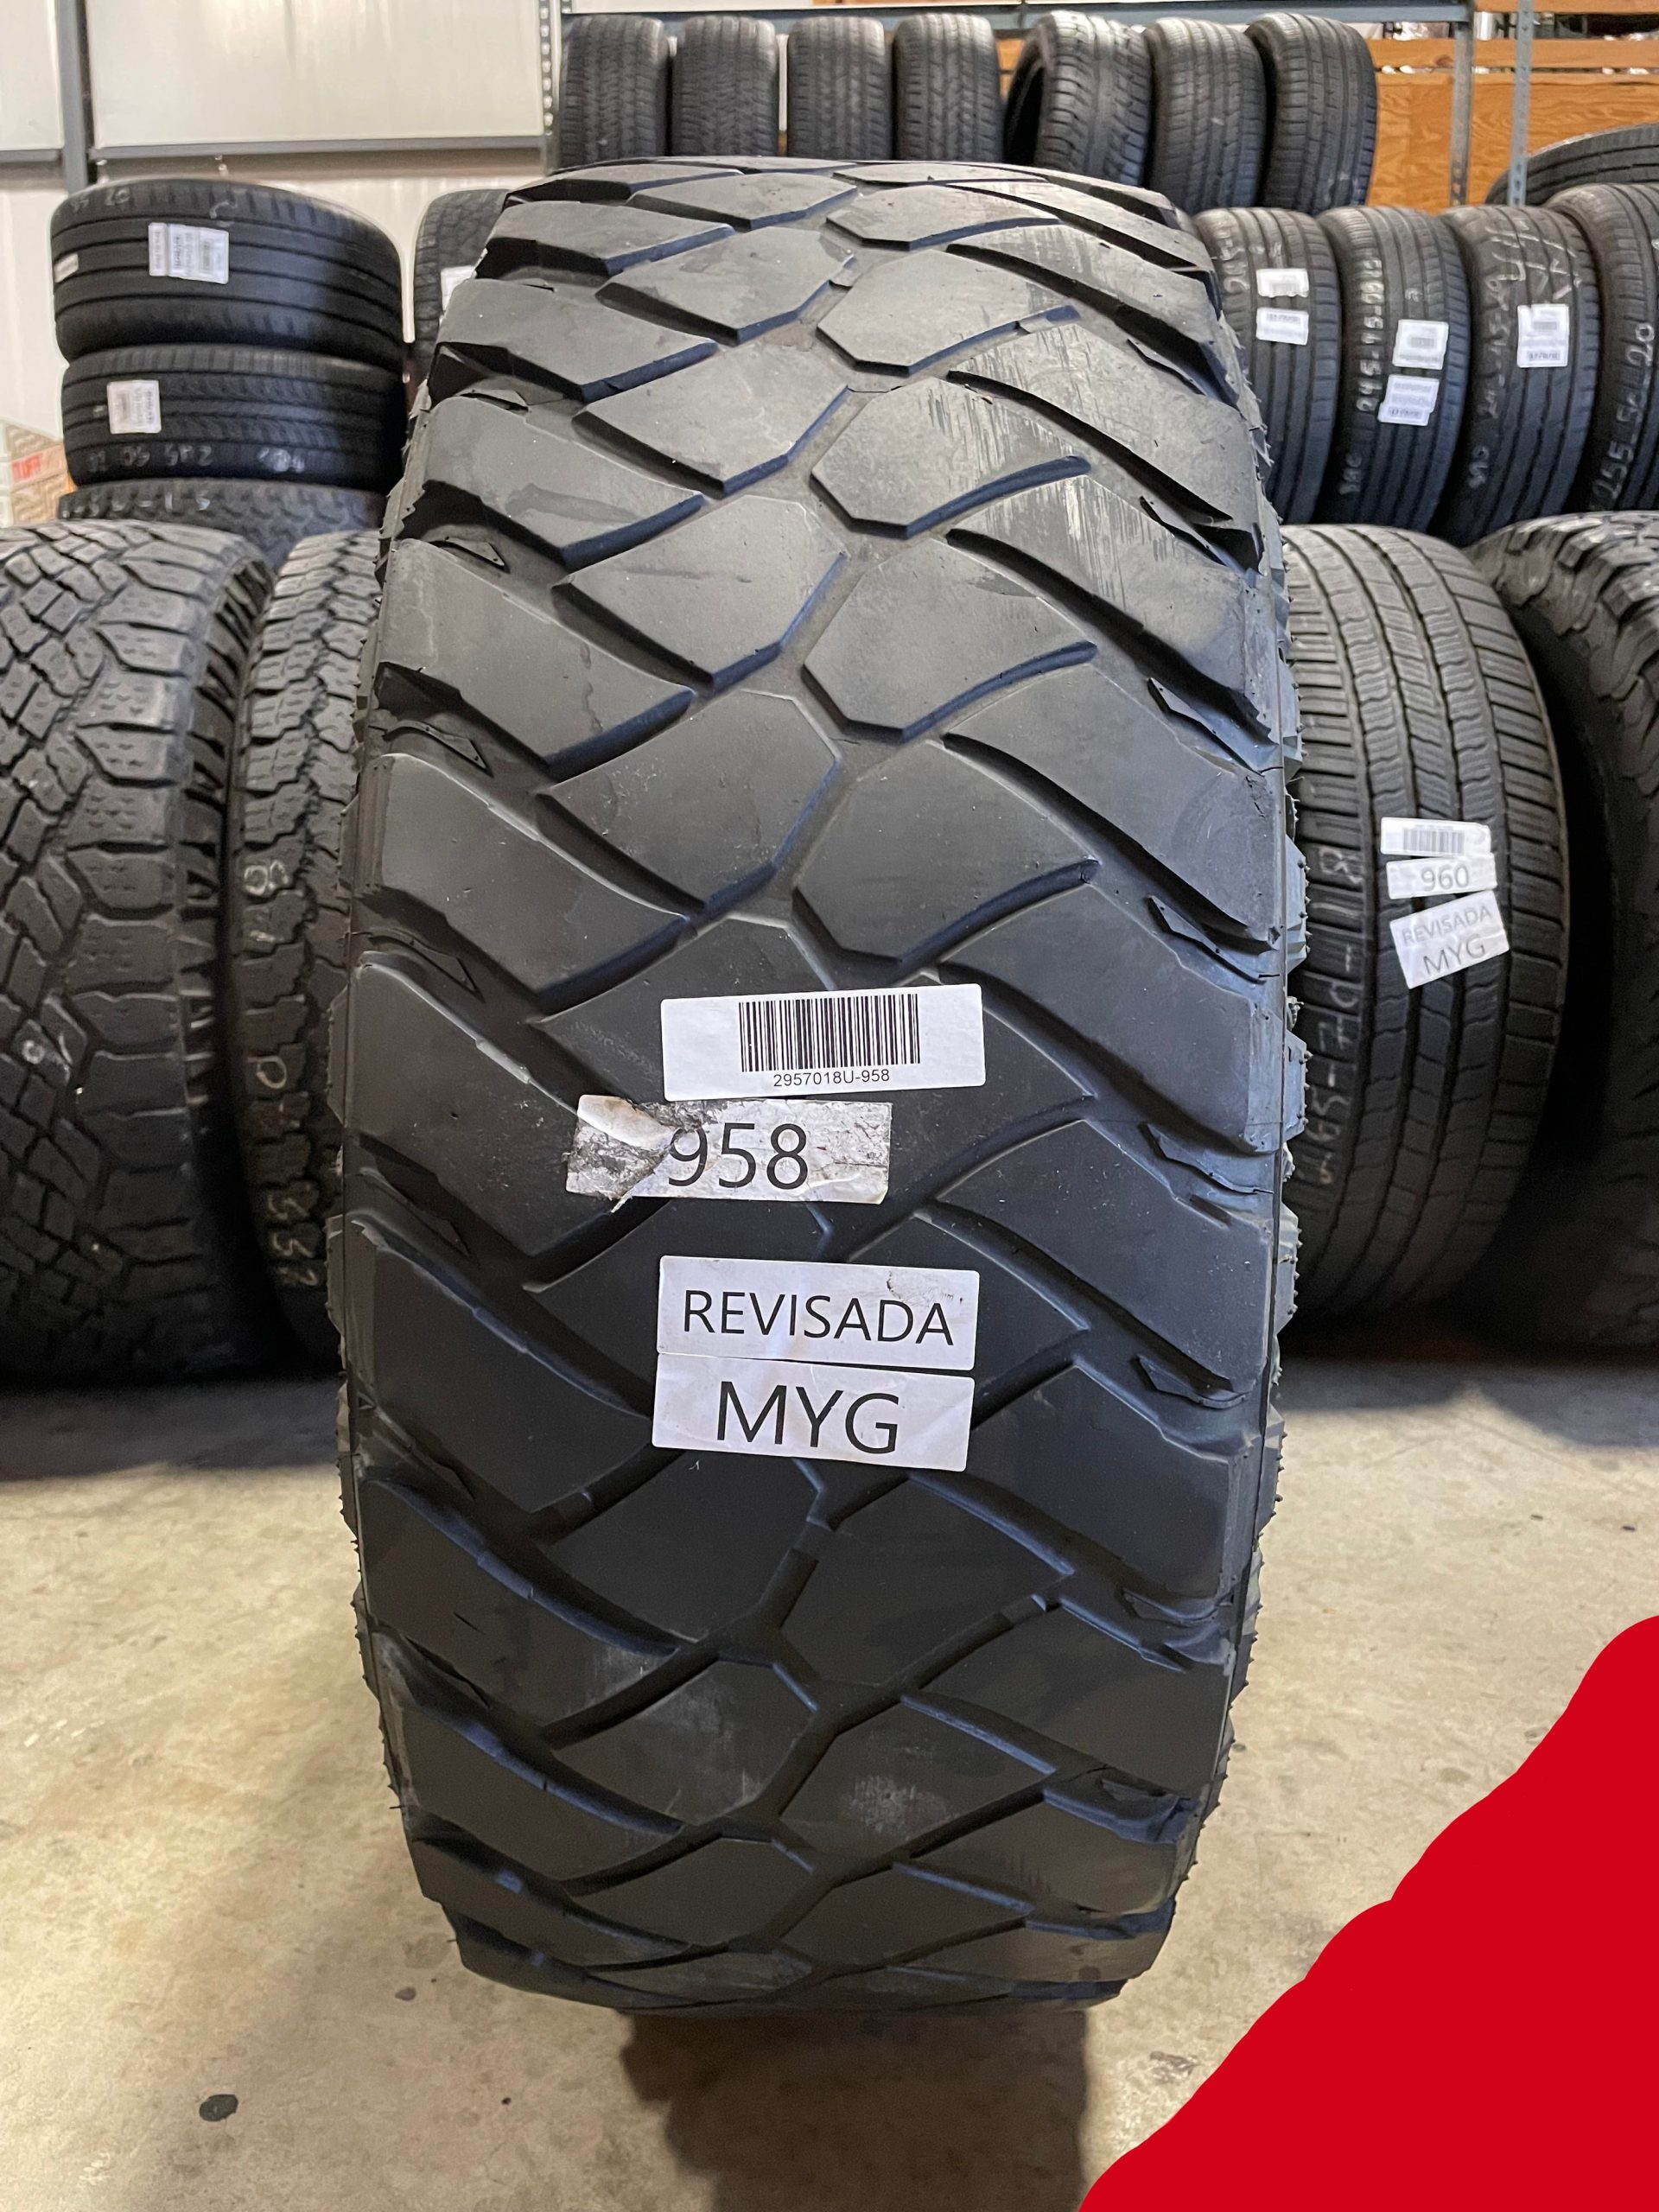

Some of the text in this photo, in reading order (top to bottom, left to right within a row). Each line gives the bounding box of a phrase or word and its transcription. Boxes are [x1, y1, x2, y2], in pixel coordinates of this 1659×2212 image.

[1421, 864, 1470, 893] 960
[1402, 905, 1494, 948] REVISADA
[1423, 932, 1486, 976] MYG
[772, 1069, 891, 1088] 2957018U-958
[667, 1122, 810, 1191] 958
[683, 1289, 954, 1346] REVISADA
[716, 1380, 900, 1455] MYG
